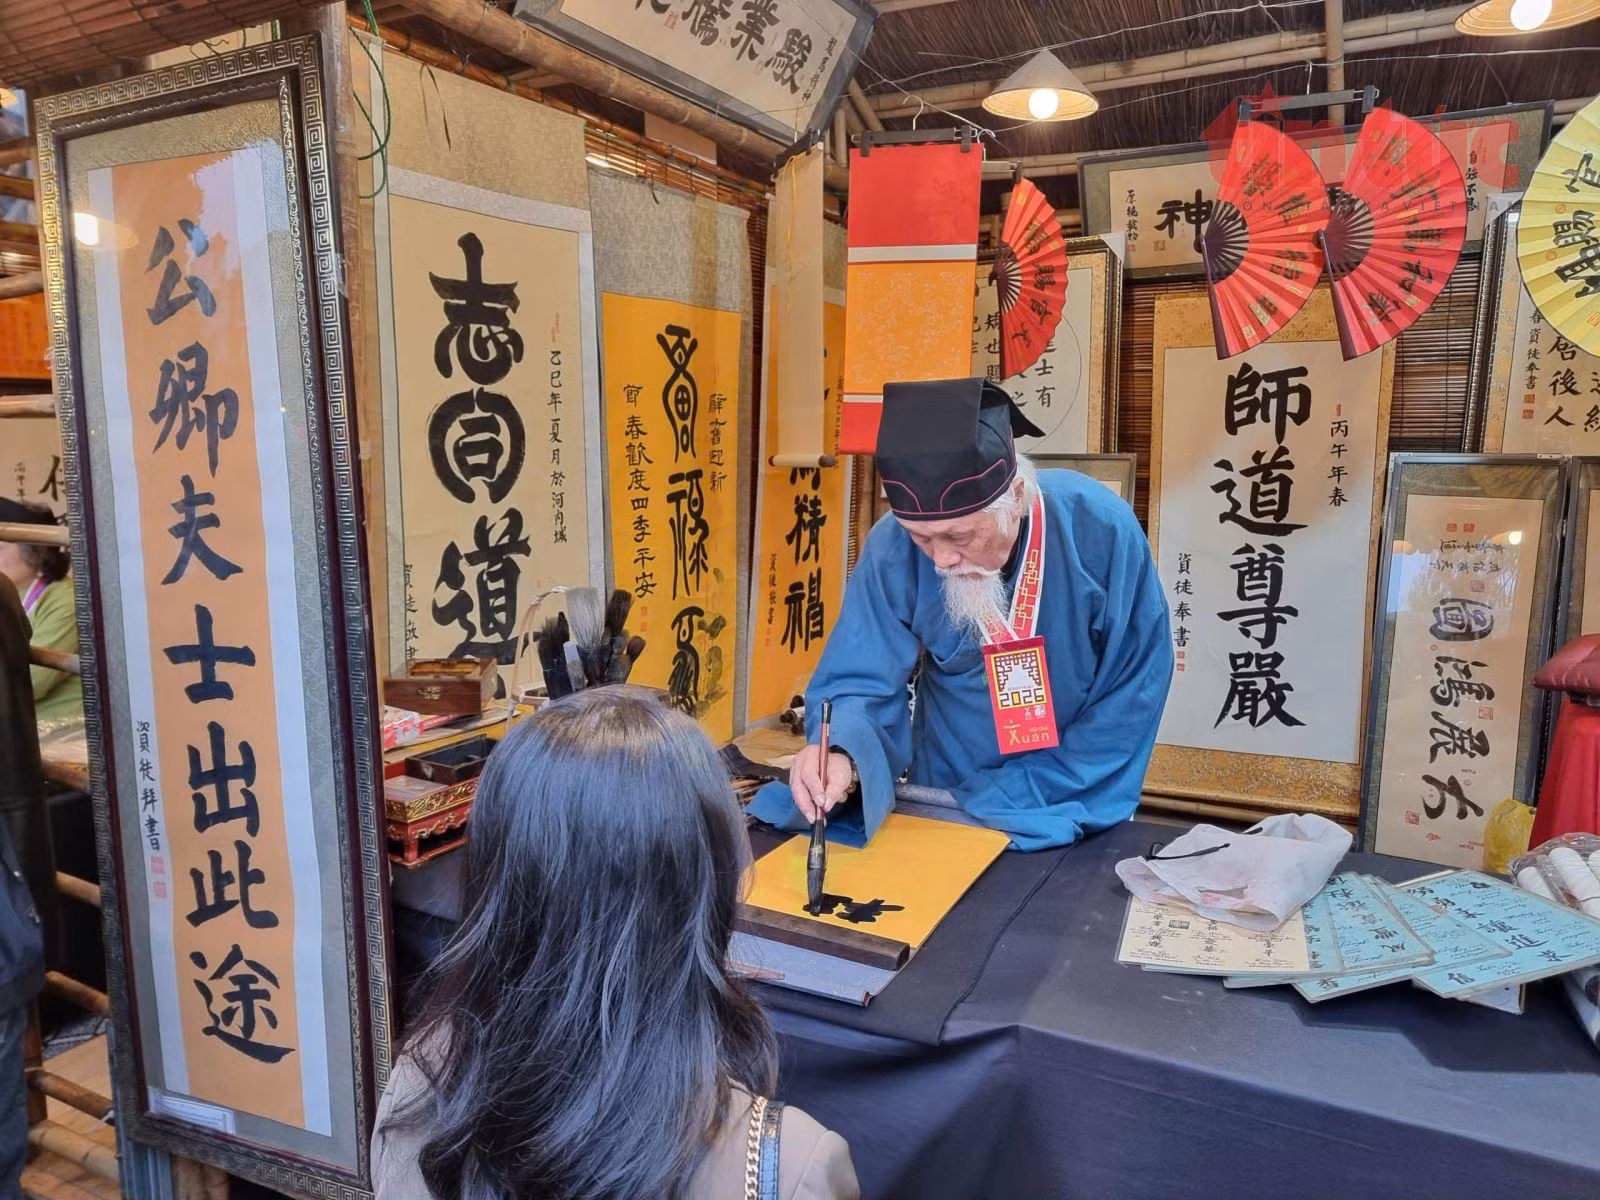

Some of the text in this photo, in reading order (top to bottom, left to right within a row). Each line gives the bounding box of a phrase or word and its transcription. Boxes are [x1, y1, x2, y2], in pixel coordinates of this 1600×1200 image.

[428, 232, 542, 699] 志同道
[1210, 361, 1310, 729] 師道尊嚴
[1326, 419, 1350, 507] 丙午年春
[143, 218, 297, 1065] 公卿夫士出此途
[999, 687, 1046, 708] 2026
[1173, 552, 1195, 648] 資徒奉書
